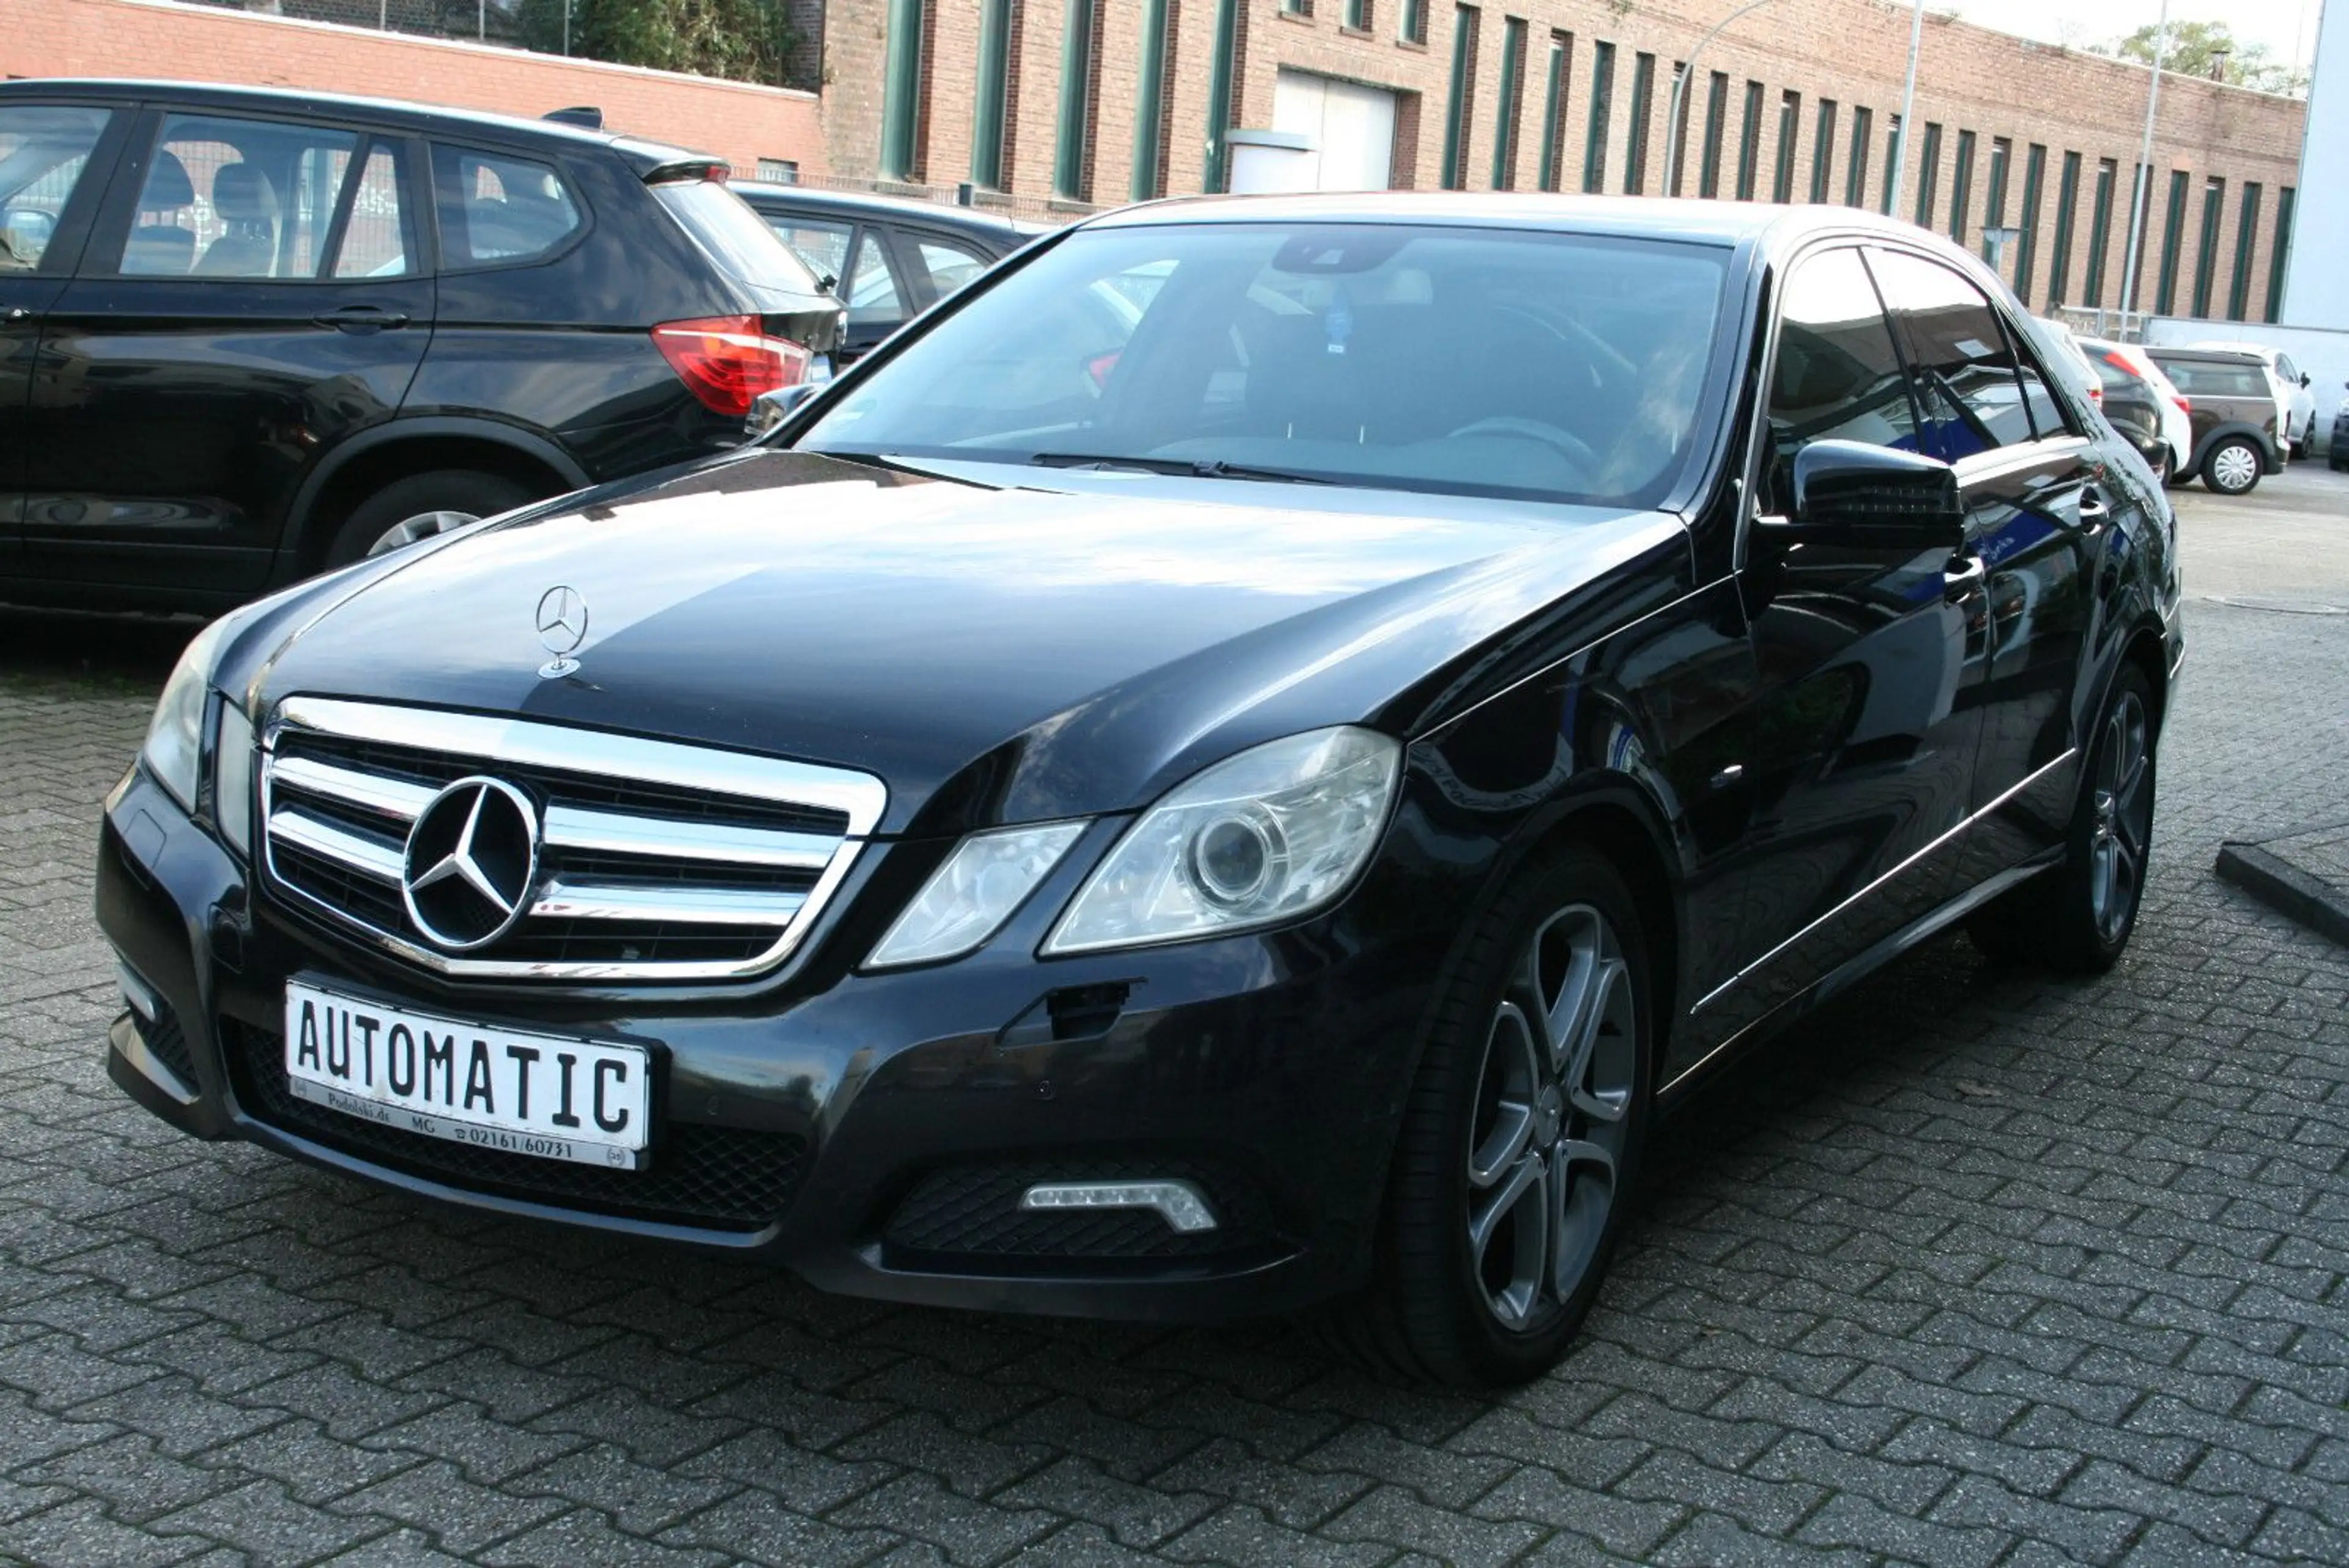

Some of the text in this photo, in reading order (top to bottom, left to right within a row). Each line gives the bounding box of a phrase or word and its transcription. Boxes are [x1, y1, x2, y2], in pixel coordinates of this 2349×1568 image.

[298, 999, 629, 1133] AUTOMATIC
[412, 1117, 435, 1133] MG
[470, 1129, 572, 1158] 02161/60731
